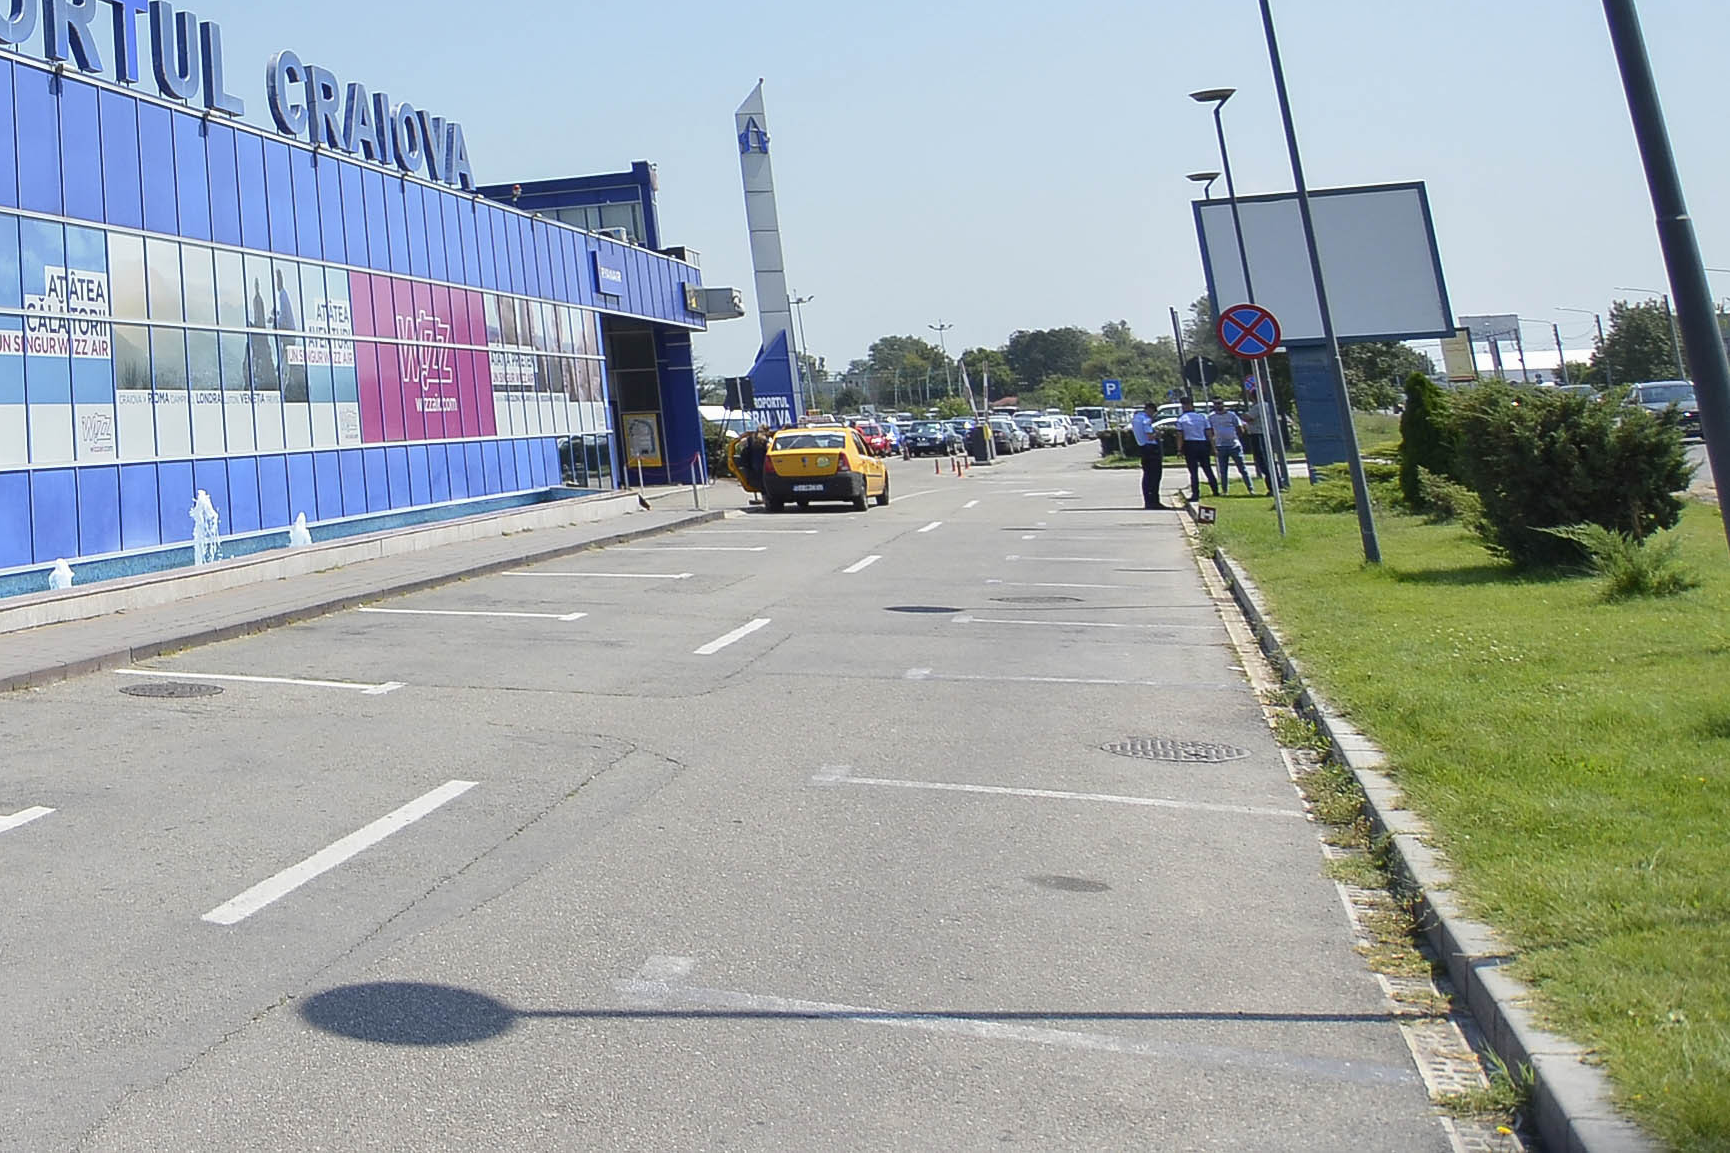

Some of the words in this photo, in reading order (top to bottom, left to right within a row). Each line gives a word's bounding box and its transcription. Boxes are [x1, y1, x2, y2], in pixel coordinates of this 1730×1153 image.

[267, 50, 476, 190] CRAIOVA
[48, 271, 105, 303] ATÂTEA
[91, 340, 109, 356] AIR
[1106, 383, 1116, 395] P
